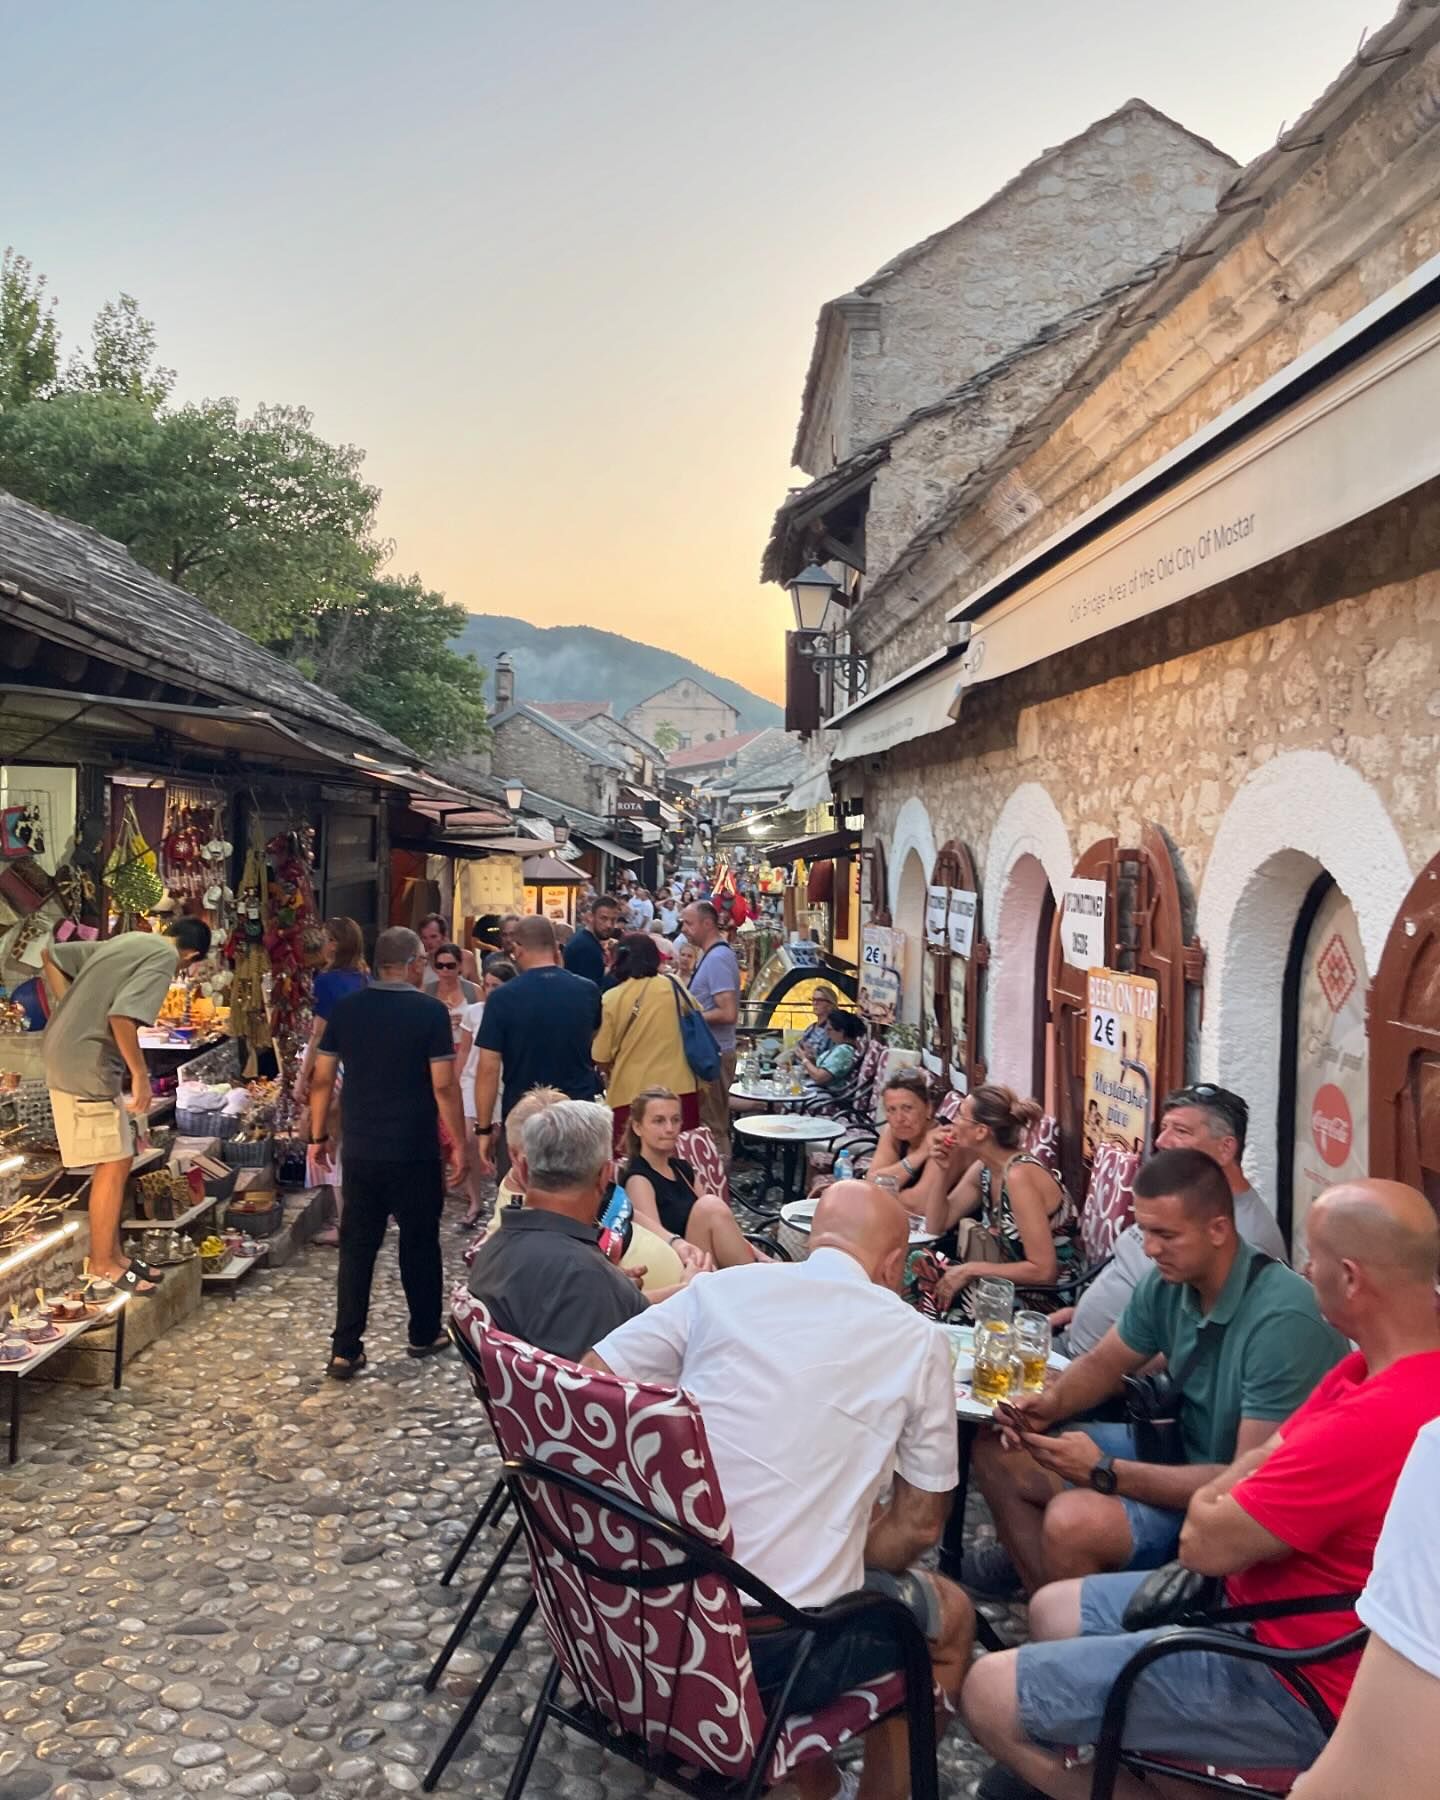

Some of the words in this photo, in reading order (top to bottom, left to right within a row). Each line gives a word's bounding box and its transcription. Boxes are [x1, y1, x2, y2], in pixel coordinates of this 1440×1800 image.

[1108, 582, 1127, 602] Area
[1129, 571, 1139, 595] of
[1139, 567, 1155, 590] the
[1157, 553, 1174, 581] Old
[1176, 545, 1196, 572] City
[1199, 530, 1212, 559] Of
[1213, 513, 1256, 553] Mostar
[617, 802, 643, 810] ROTA
[866, 946, 880, 964] 2€
[1089, 976, 1113, 1010] BEER
[1115, 983, 1133, 1016] ON
[1136, 987, 1156, 1020] TAP
